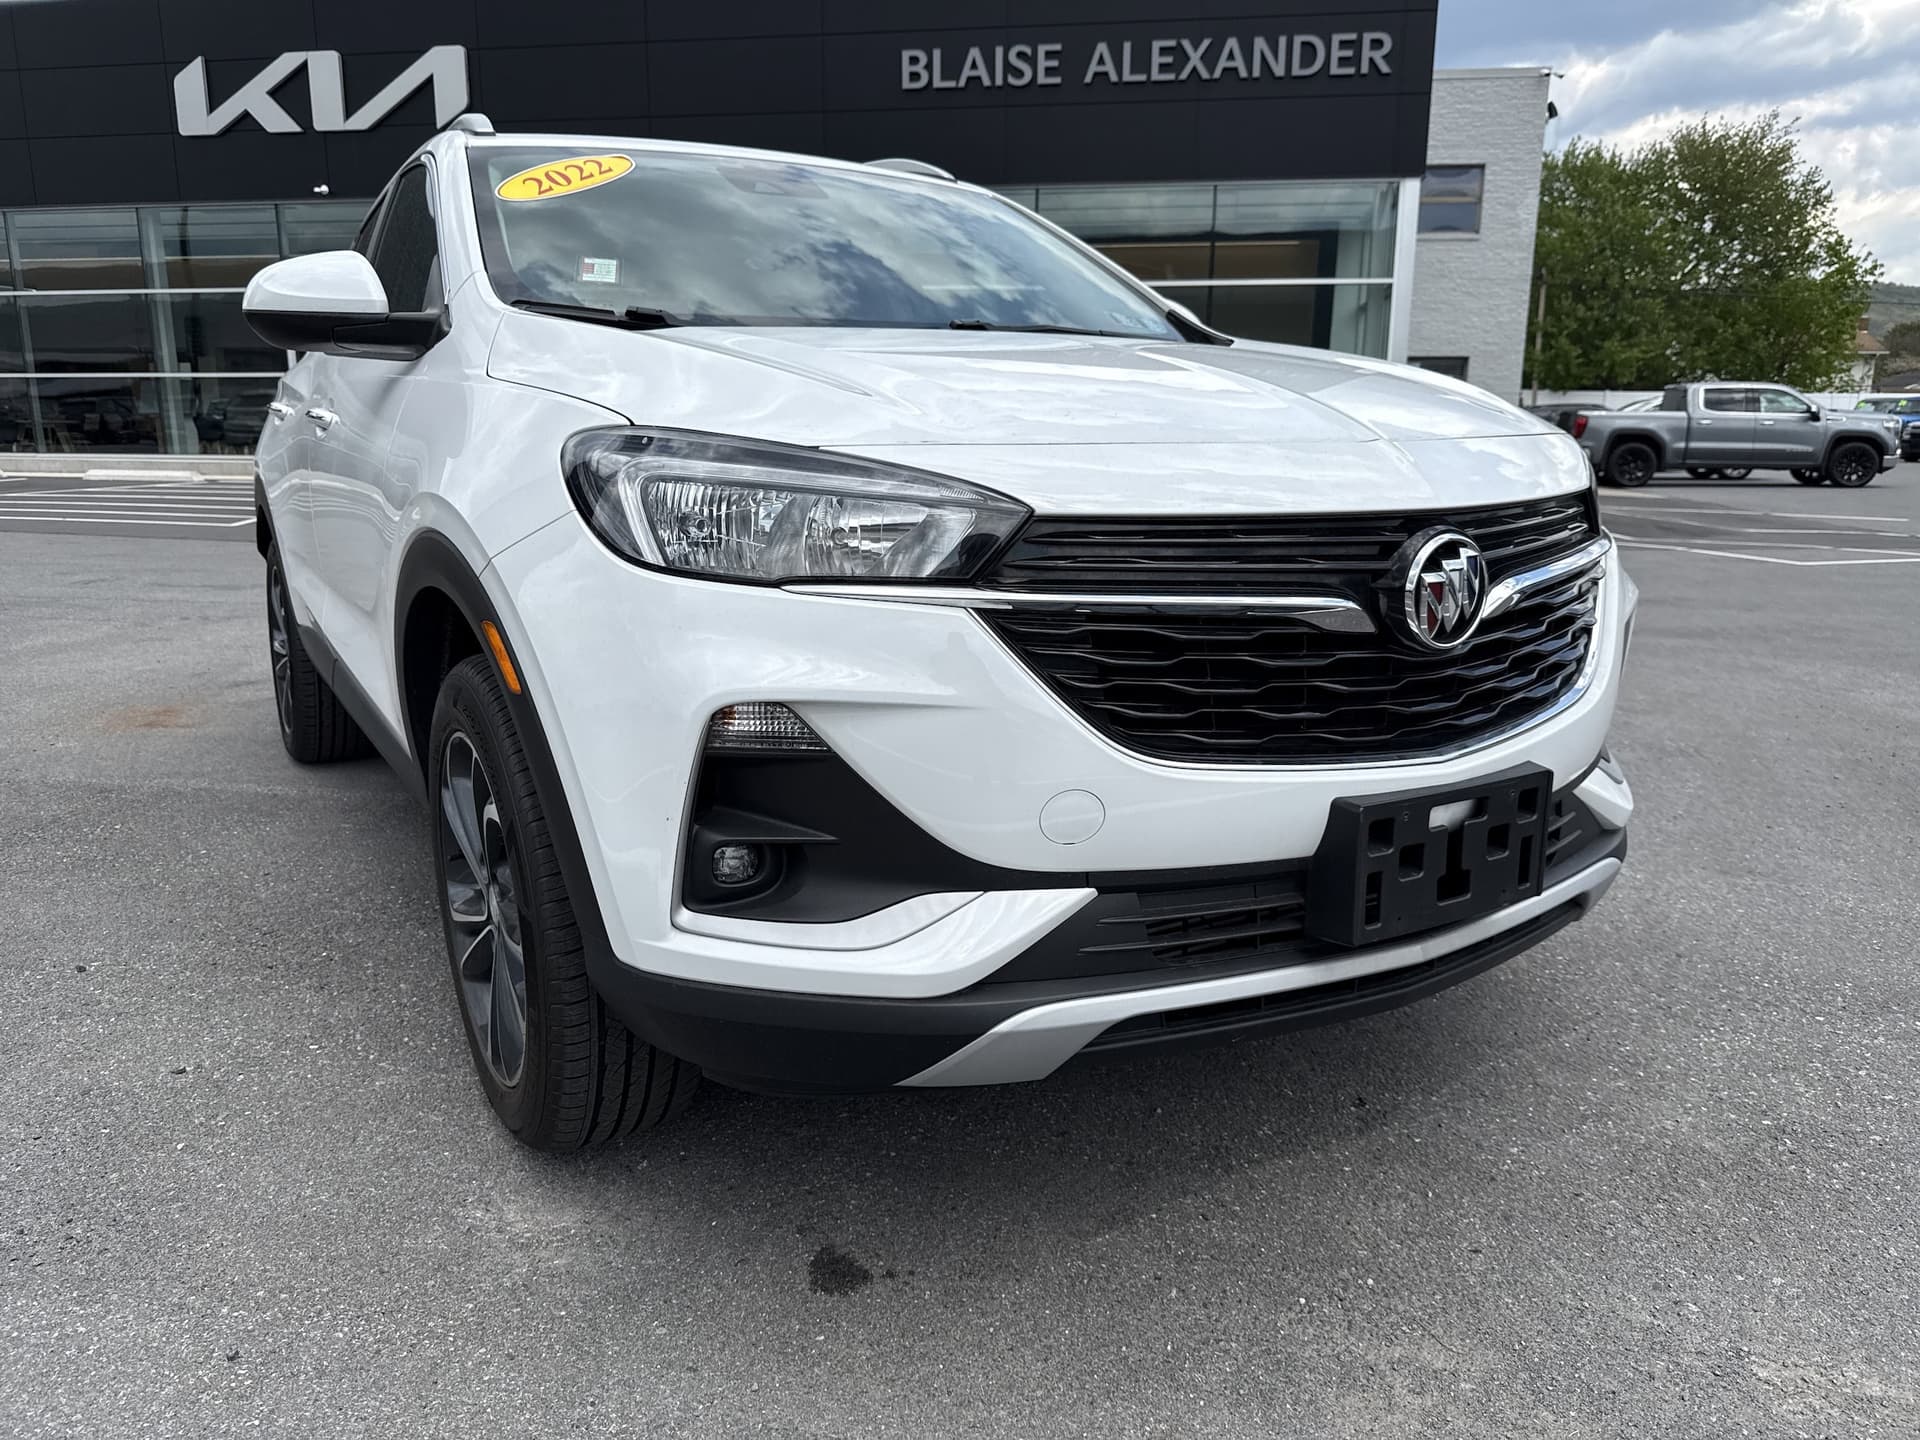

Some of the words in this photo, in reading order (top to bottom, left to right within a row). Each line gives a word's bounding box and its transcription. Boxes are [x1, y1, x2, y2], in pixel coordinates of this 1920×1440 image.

[901, 43, 1062, 89] BLAISE
[1084, 32, 1392, 83] ALEXANDER
[174, 45, 469, 136] KIA
[522, 159, 613, 195] 2022
